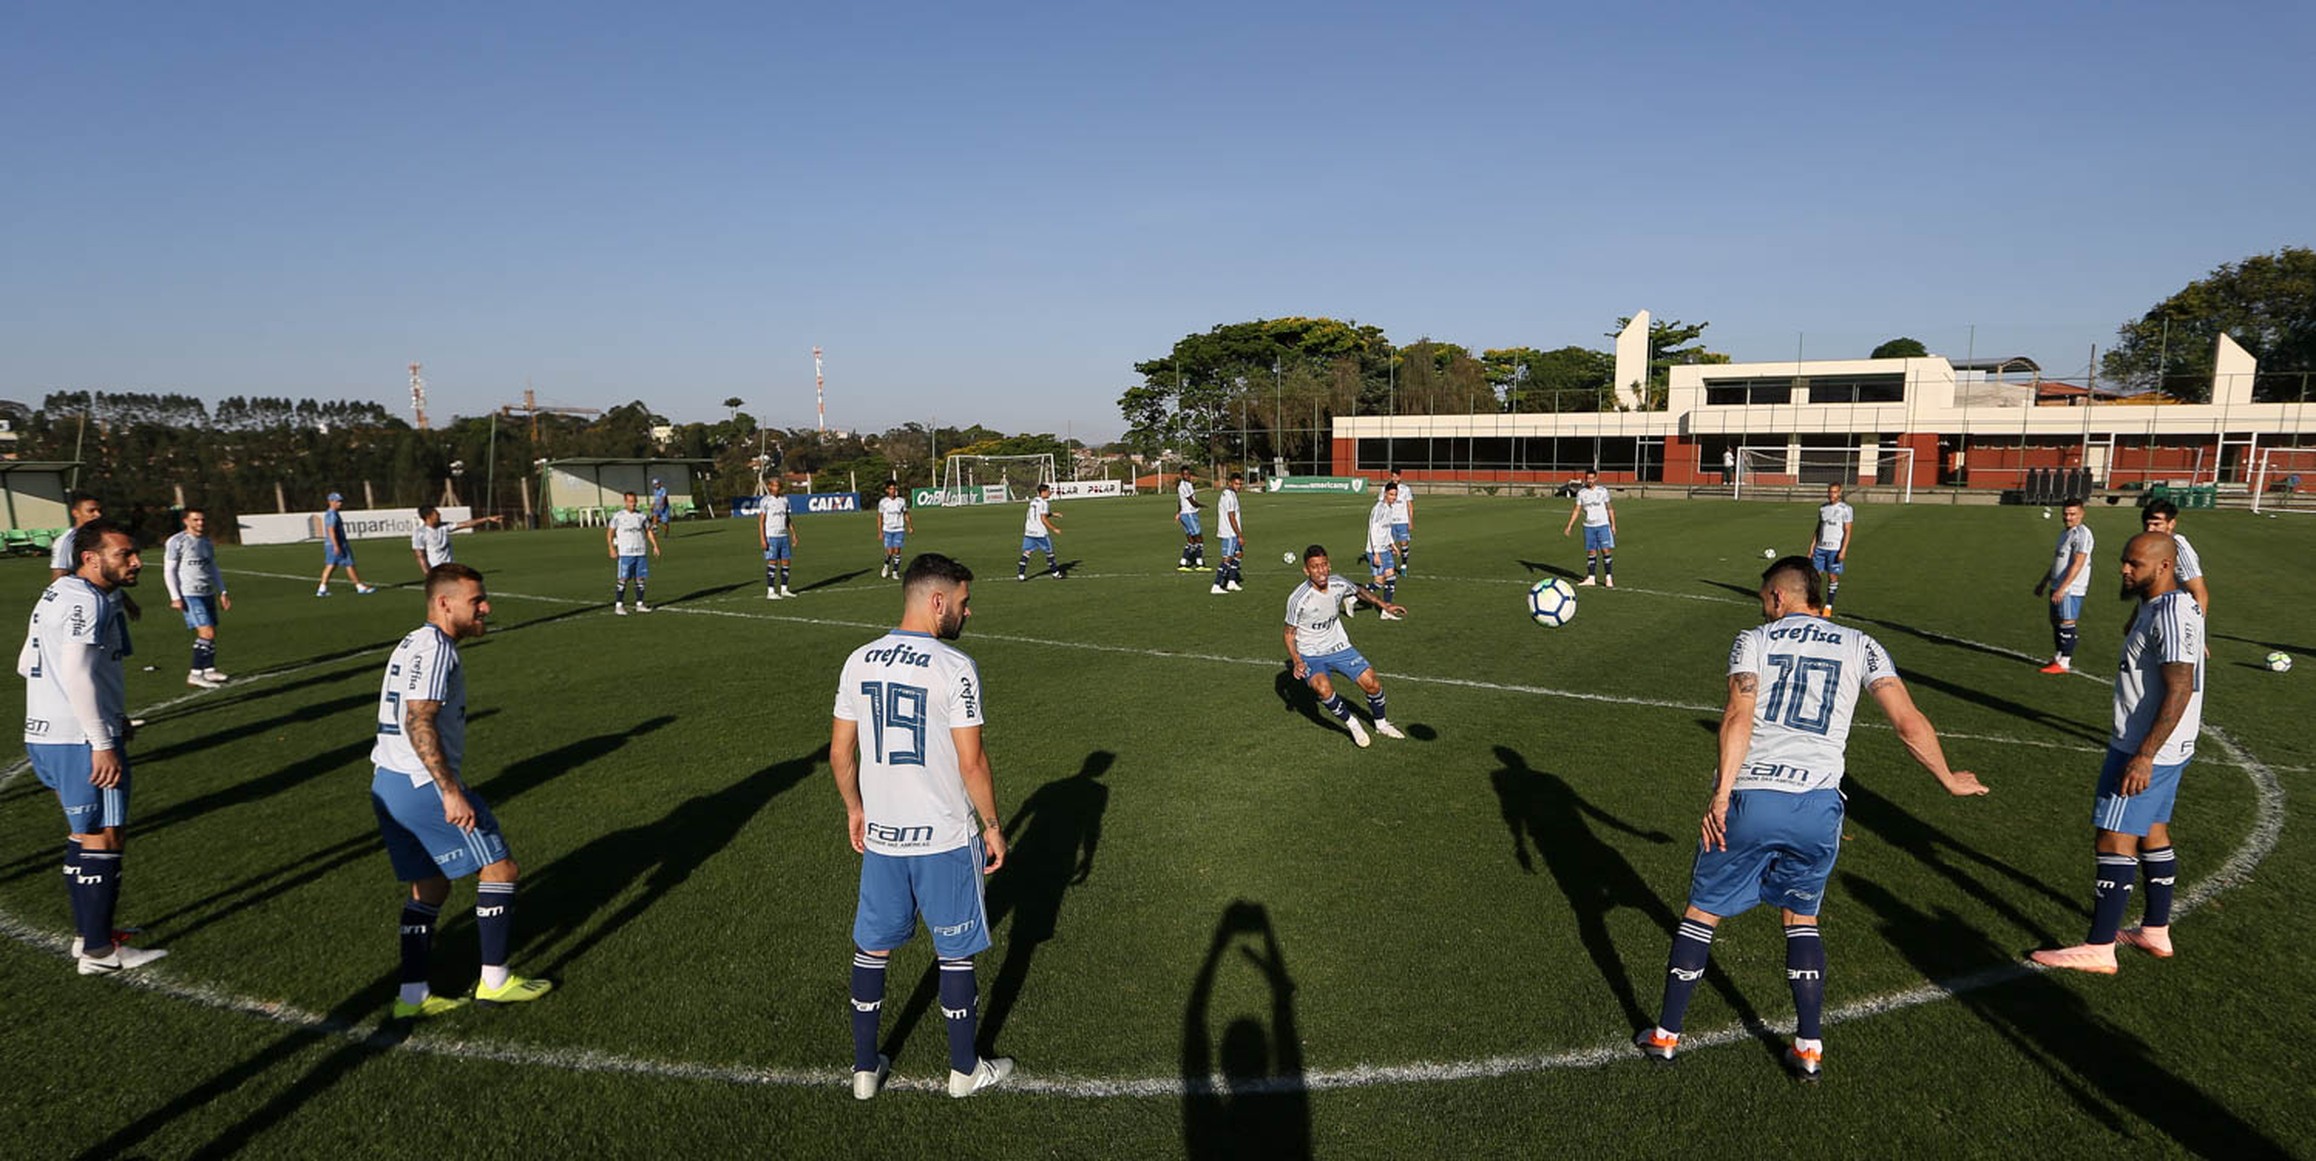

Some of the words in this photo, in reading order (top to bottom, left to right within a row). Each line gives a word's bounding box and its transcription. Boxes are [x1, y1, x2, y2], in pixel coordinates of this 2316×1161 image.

[808, 496, 854, 512] CAIXA
[1768, 623, 1843, 645] crefisa
[864, 644, 932, 667] crefisa
[961, 677, 975, 718] crefisa
[1764, 653, 1843, 736] 10
[861, 681, 928, 766] 19
[434, 849, 463, 865] am
[476, 906, 504, 917] am
[1787, 969, 1820, 980] am
